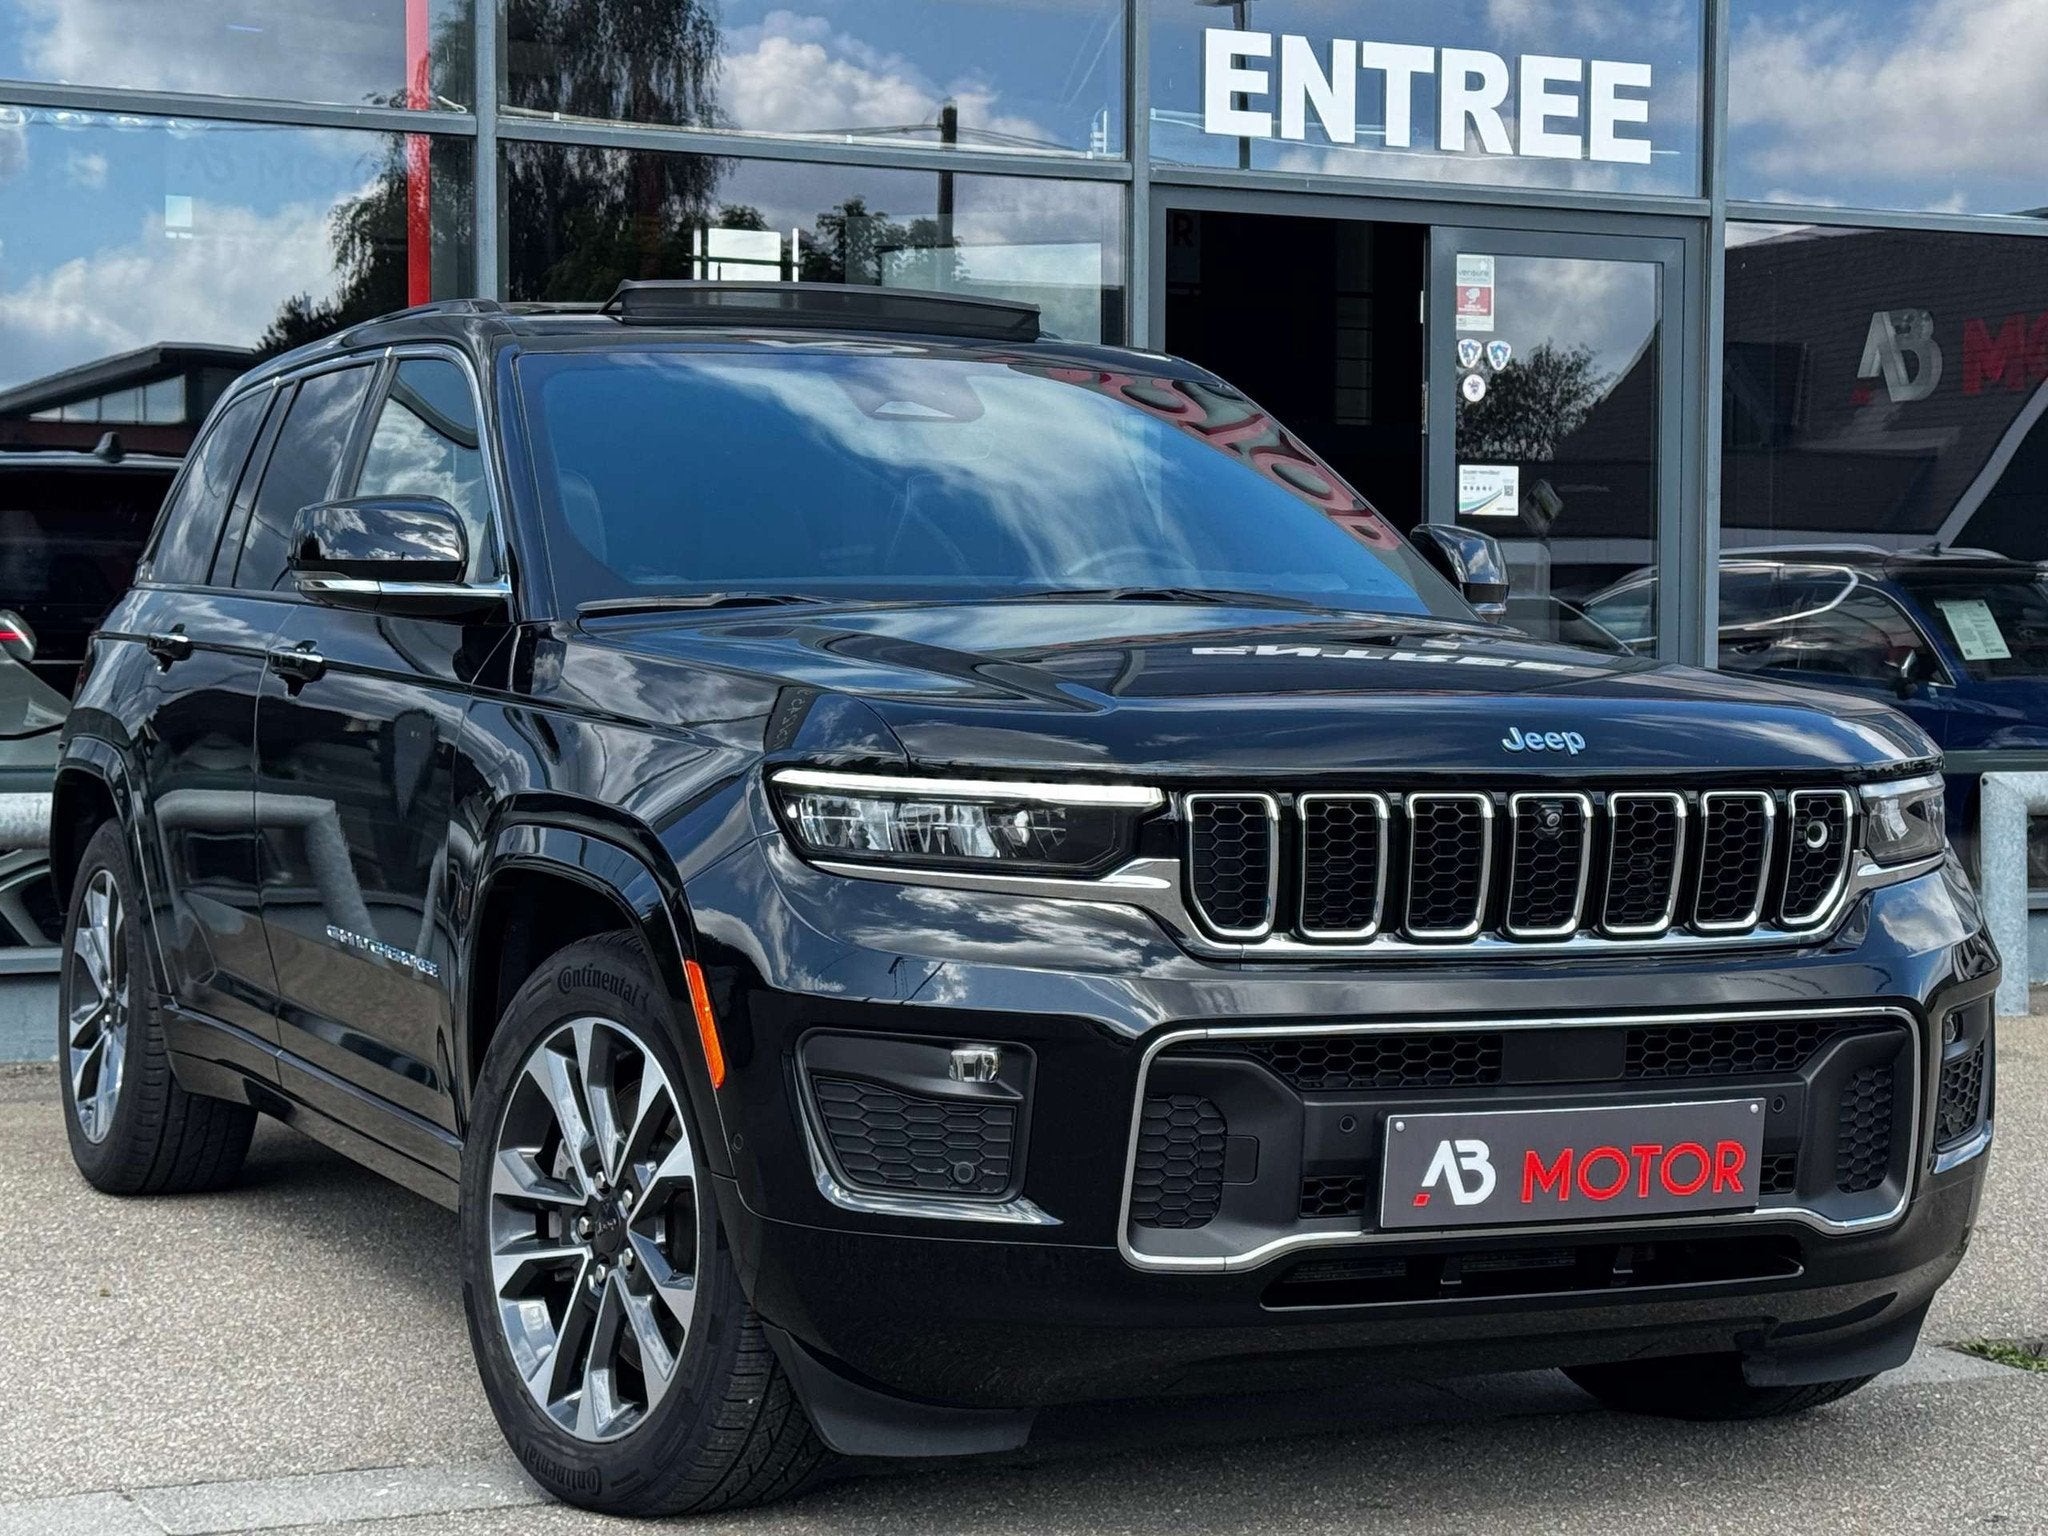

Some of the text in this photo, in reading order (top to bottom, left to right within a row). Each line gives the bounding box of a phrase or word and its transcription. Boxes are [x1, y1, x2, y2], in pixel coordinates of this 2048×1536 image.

[1204, 28, 1653, 164] ENTREE
[1502, 726, 1586, 755] Jeep
[558, 962, 640, 1007] Continental
[1414, 1139, 1747, 1206] AB MOTOR
